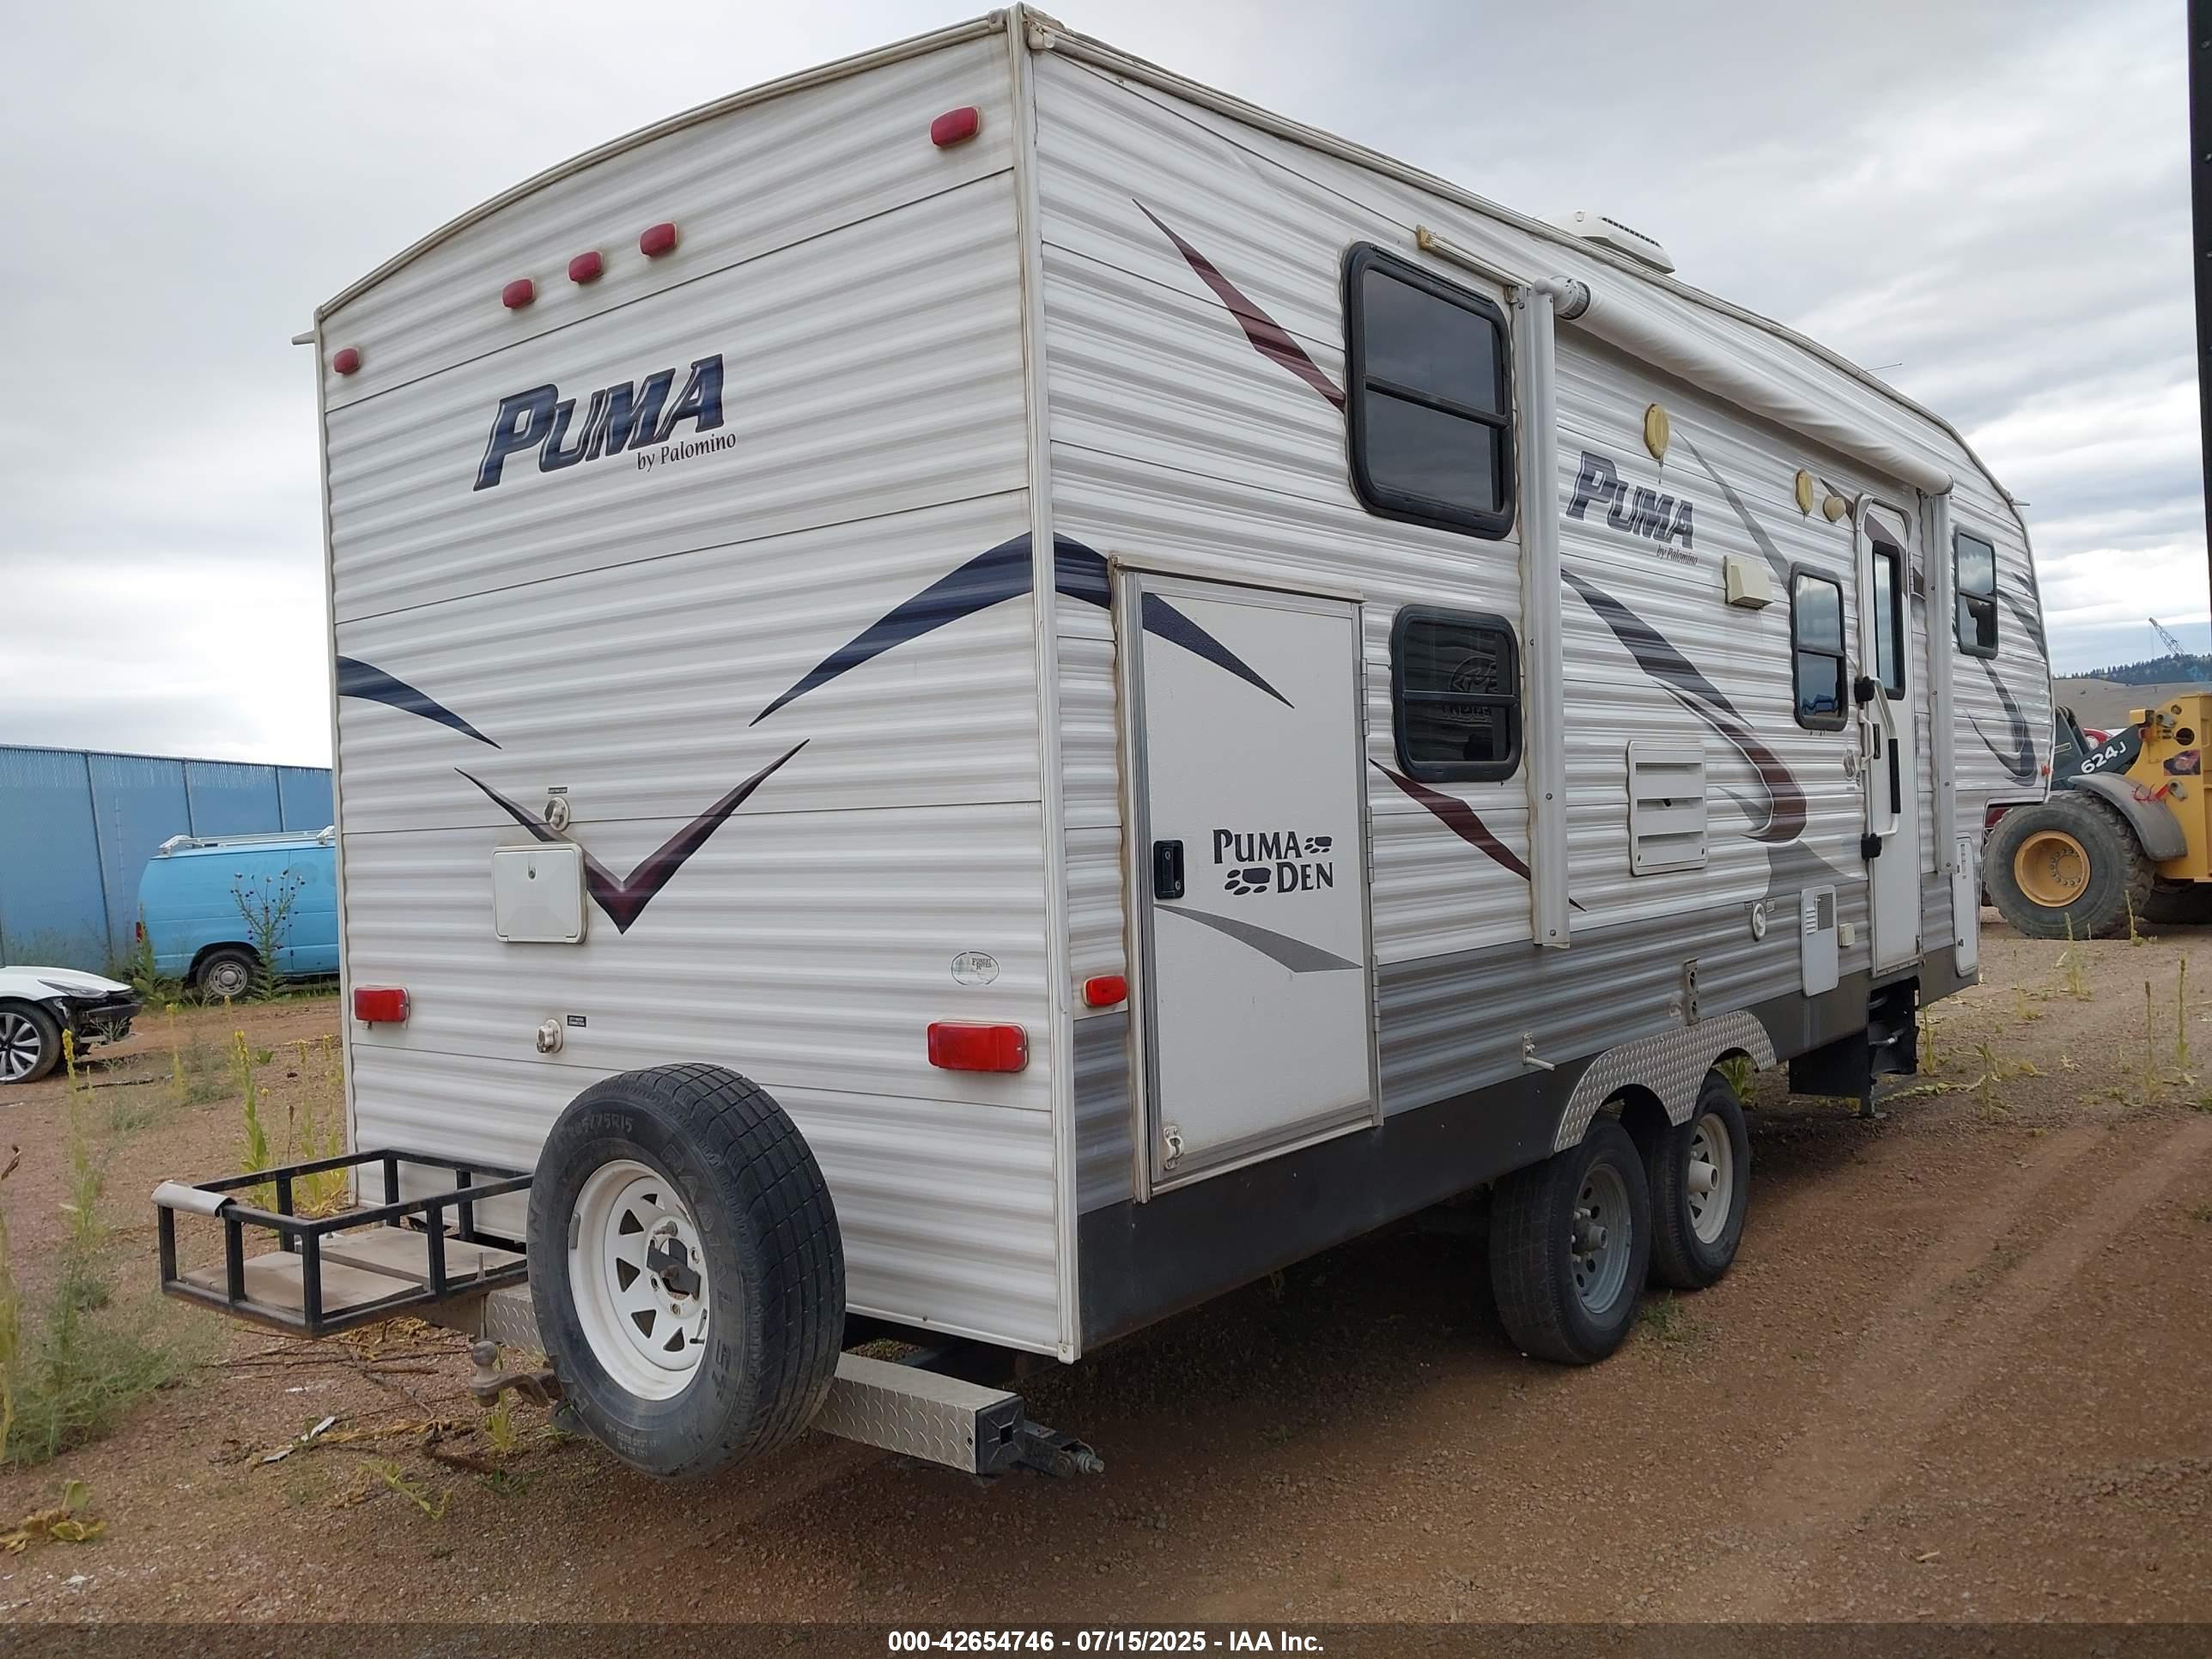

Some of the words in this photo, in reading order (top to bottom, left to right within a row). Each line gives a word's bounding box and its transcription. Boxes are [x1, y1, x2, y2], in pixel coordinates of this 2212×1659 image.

[473, 353, 725, 492] PUMA
[637, 452, 655, 472] by
[659, 432, 737, 465] Palomino
[1565, 451, 1694, 550] PUMA
[1656, 544, 1667, 559] by
[1667, 546, 1698, 567] Palomino
[2081, 740, 2127, 774] 624J
[1212, 829, 1303, 865] PUMA
[1275, 861, 1334, 894] DEN
